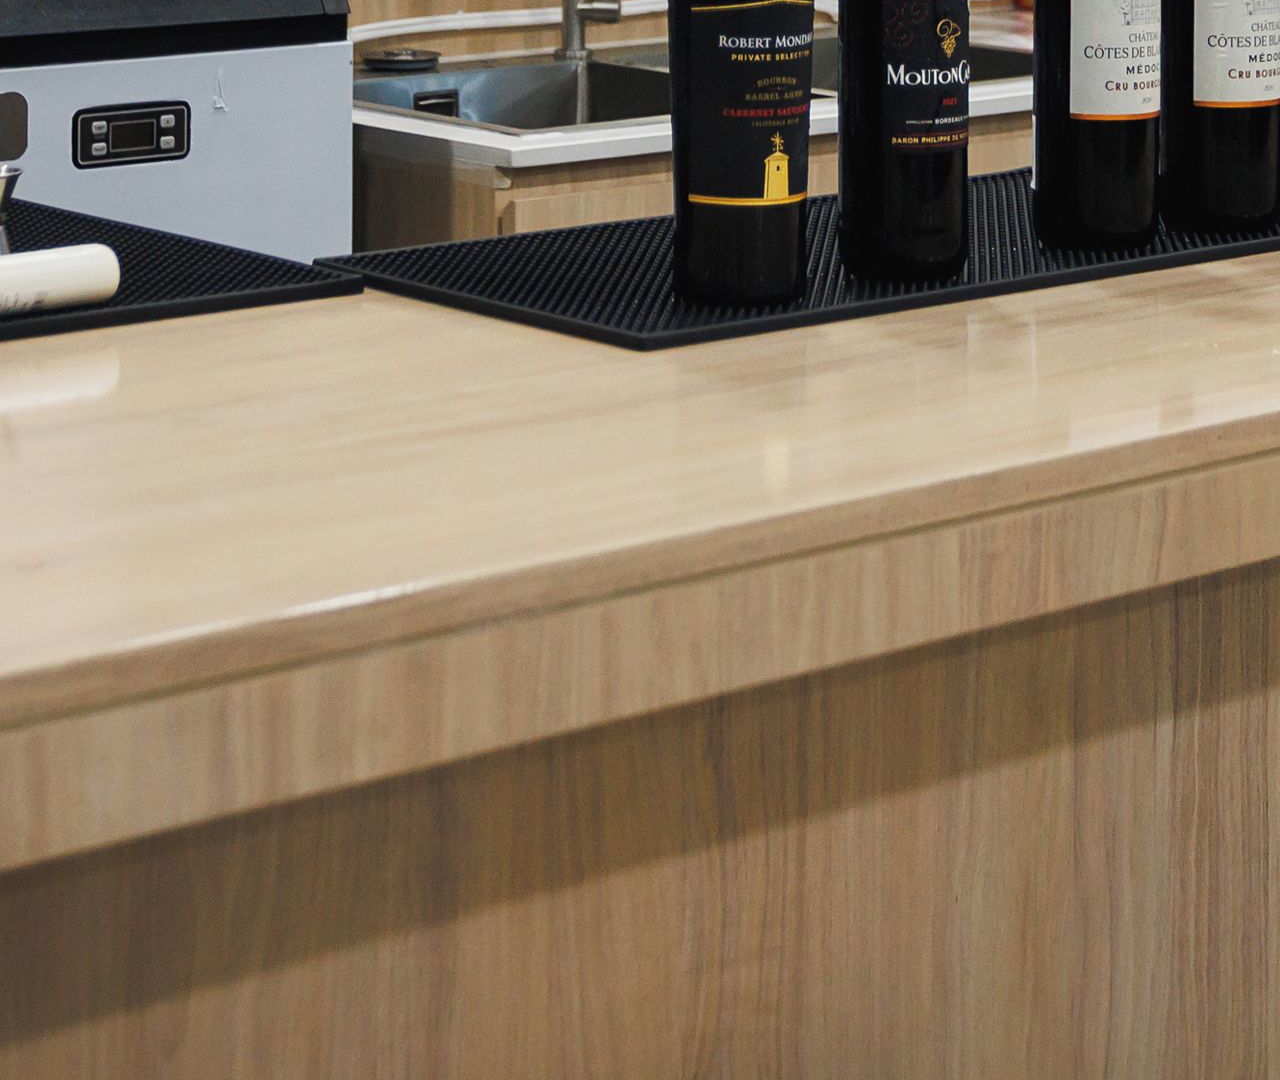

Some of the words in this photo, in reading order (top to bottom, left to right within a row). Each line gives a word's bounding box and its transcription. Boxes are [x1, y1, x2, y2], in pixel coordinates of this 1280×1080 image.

[719, 35, 772, 48] ROBERT
[1207, 33, 1252, 48] CÔTES
[1253, 35, 1267, 47] DE
[731, 53, 771, 61] PRIVATE
[1083, 43, 1129, 59] CÔTES
[1131, 46, 1145, 58] DE
[1228, 68, 1251, 79] CRU
[1105, 80, 1128, 91] CRU
[722, 105, 774, 118] CABERNET
[891, 136, 919, 145] BARON
[921, 134, 950, 143] PHILIPPE
